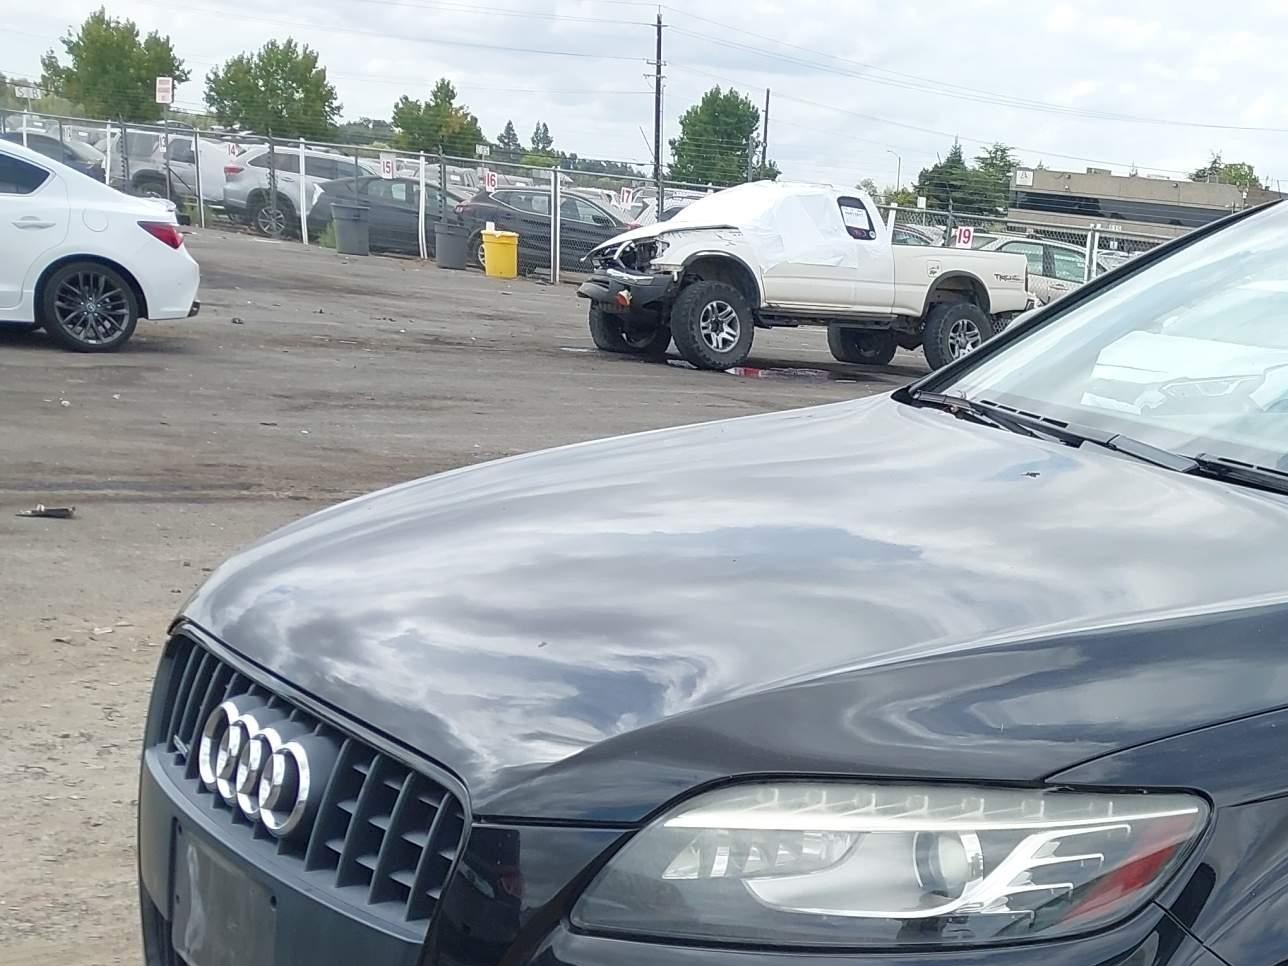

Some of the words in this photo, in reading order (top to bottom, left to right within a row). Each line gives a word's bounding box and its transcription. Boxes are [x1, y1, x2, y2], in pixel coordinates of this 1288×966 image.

[382, 160, 391, 174] 15
[487, 172, 497, 187] 16
[621, 188, 632, 204] 17
[957, 228, 971, 244] 19
